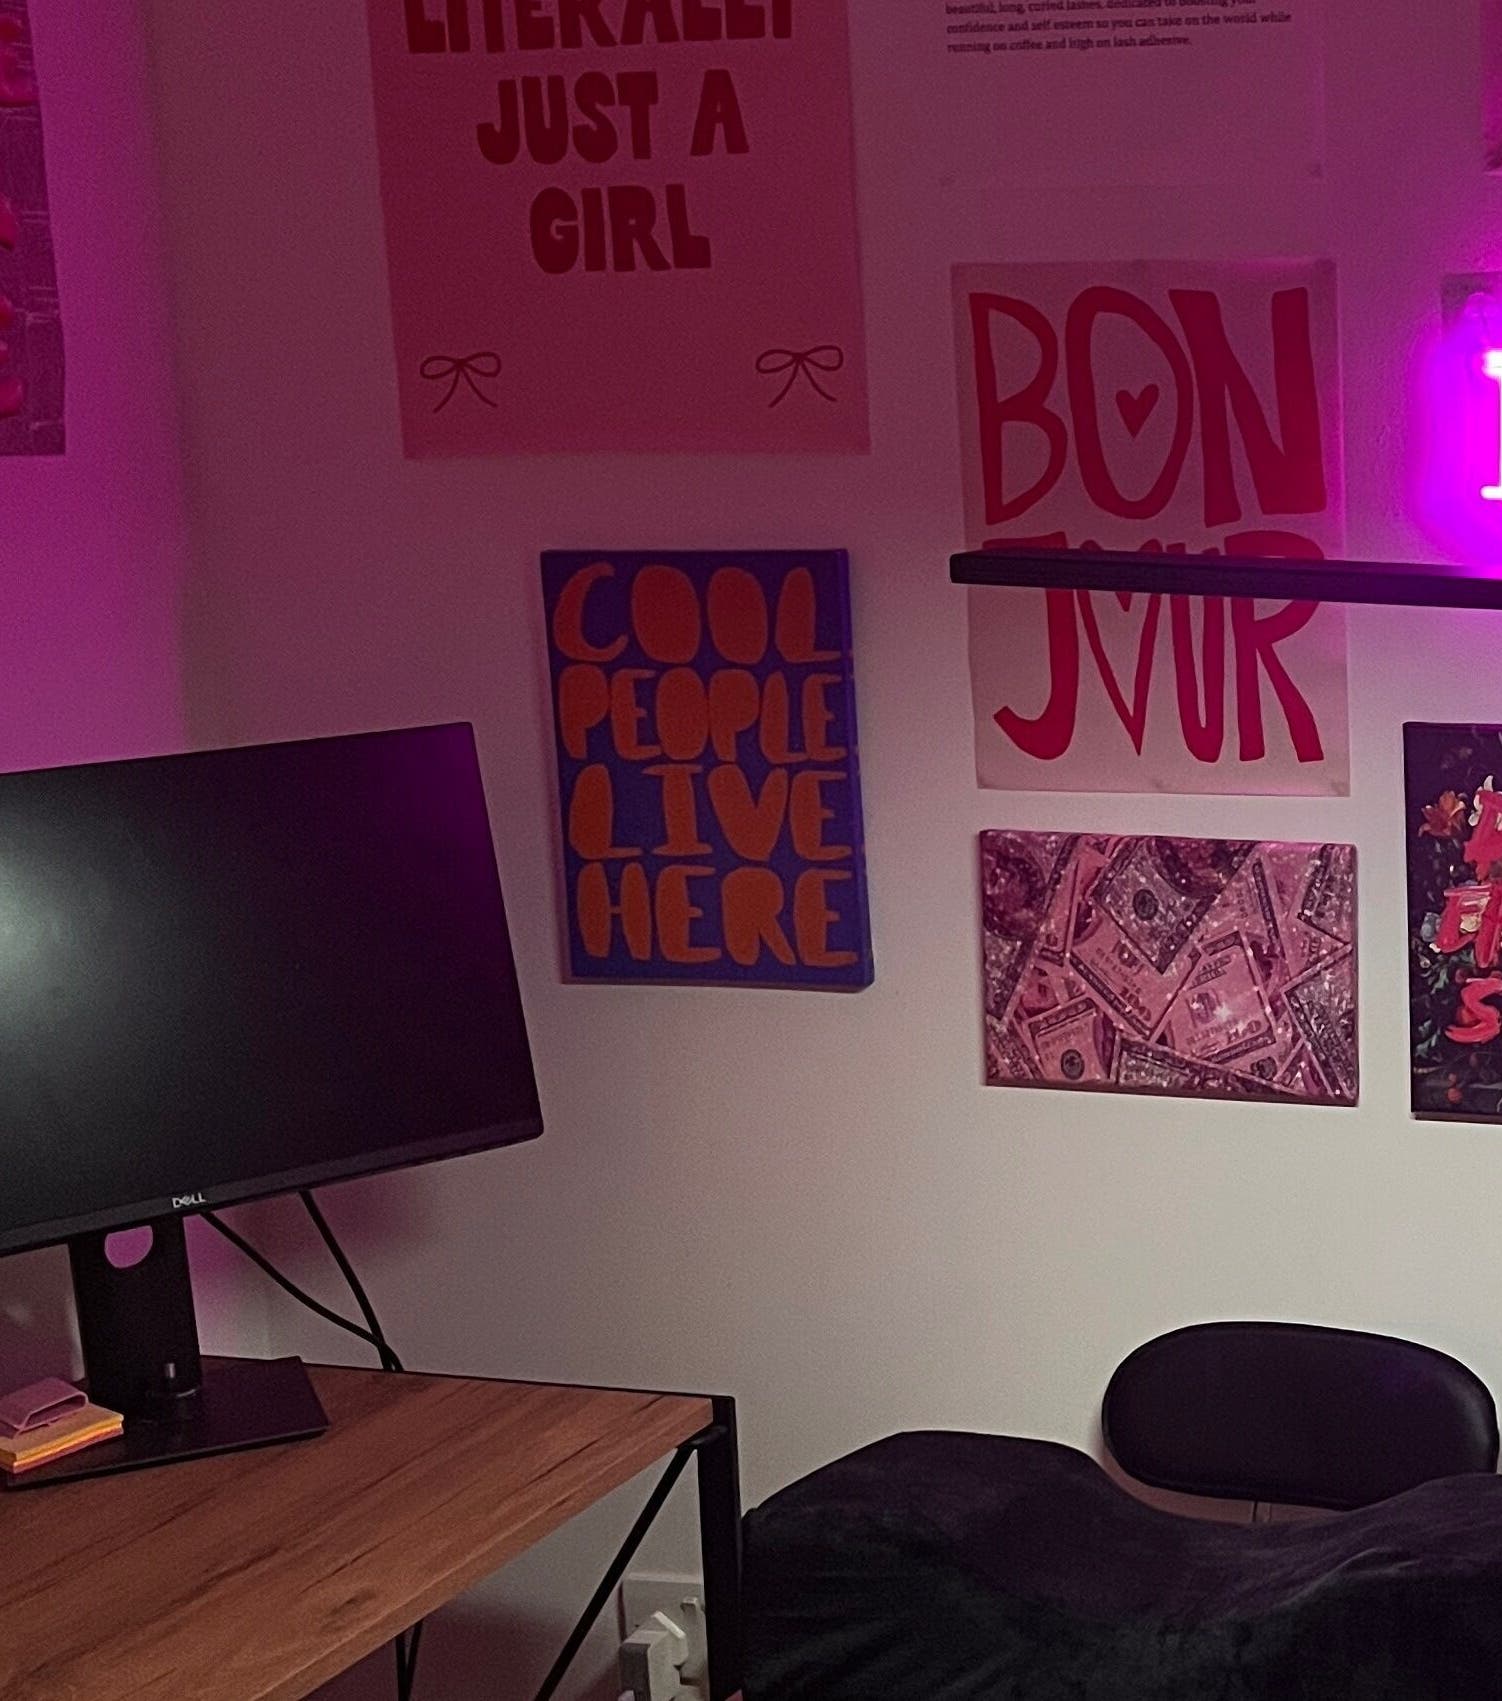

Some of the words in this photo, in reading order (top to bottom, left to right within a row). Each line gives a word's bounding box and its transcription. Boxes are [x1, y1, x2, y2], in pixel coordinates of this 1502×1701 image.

[946, 20, 1006, 33] confidence
[1007, 19, 1029, 31] and
[1030, 19, 1051, 30] self
[1095, 20, 1109, 28] so
[1111, 19, 1133, 30] you
[1134, 18, 1155, 27] can
[1156, 14, 1183, 26] take
[1184, 17, 1200, 25] on
[1201, 13, 1220, 24] the
[1260, 10, 1292, 23] while
[946, 39, 991, 54] running
[992, 42, 1008, 50] on
[1009, 38, 1043, 49] coffee
[1045, 37, 1067, 49] and
[1068, 36, 1094, 51] high
[1096, 39, 1111, 47] on
[1112, 35, 1136, 47] lash
[476, 70, 659, 166] JUST
[691, 69, 750, 157] A
[530, 184, 712, 275] GIRL
[969, 286, 1328, 527] BON
[553, 562, 841, 664] COOL
[558, 663, 849, 760] PEOPLE
[568, 763, 853, 862] LIVE
[576, 862, 859, 968] HERE
[172, 1192, 206, 1209] DELL
